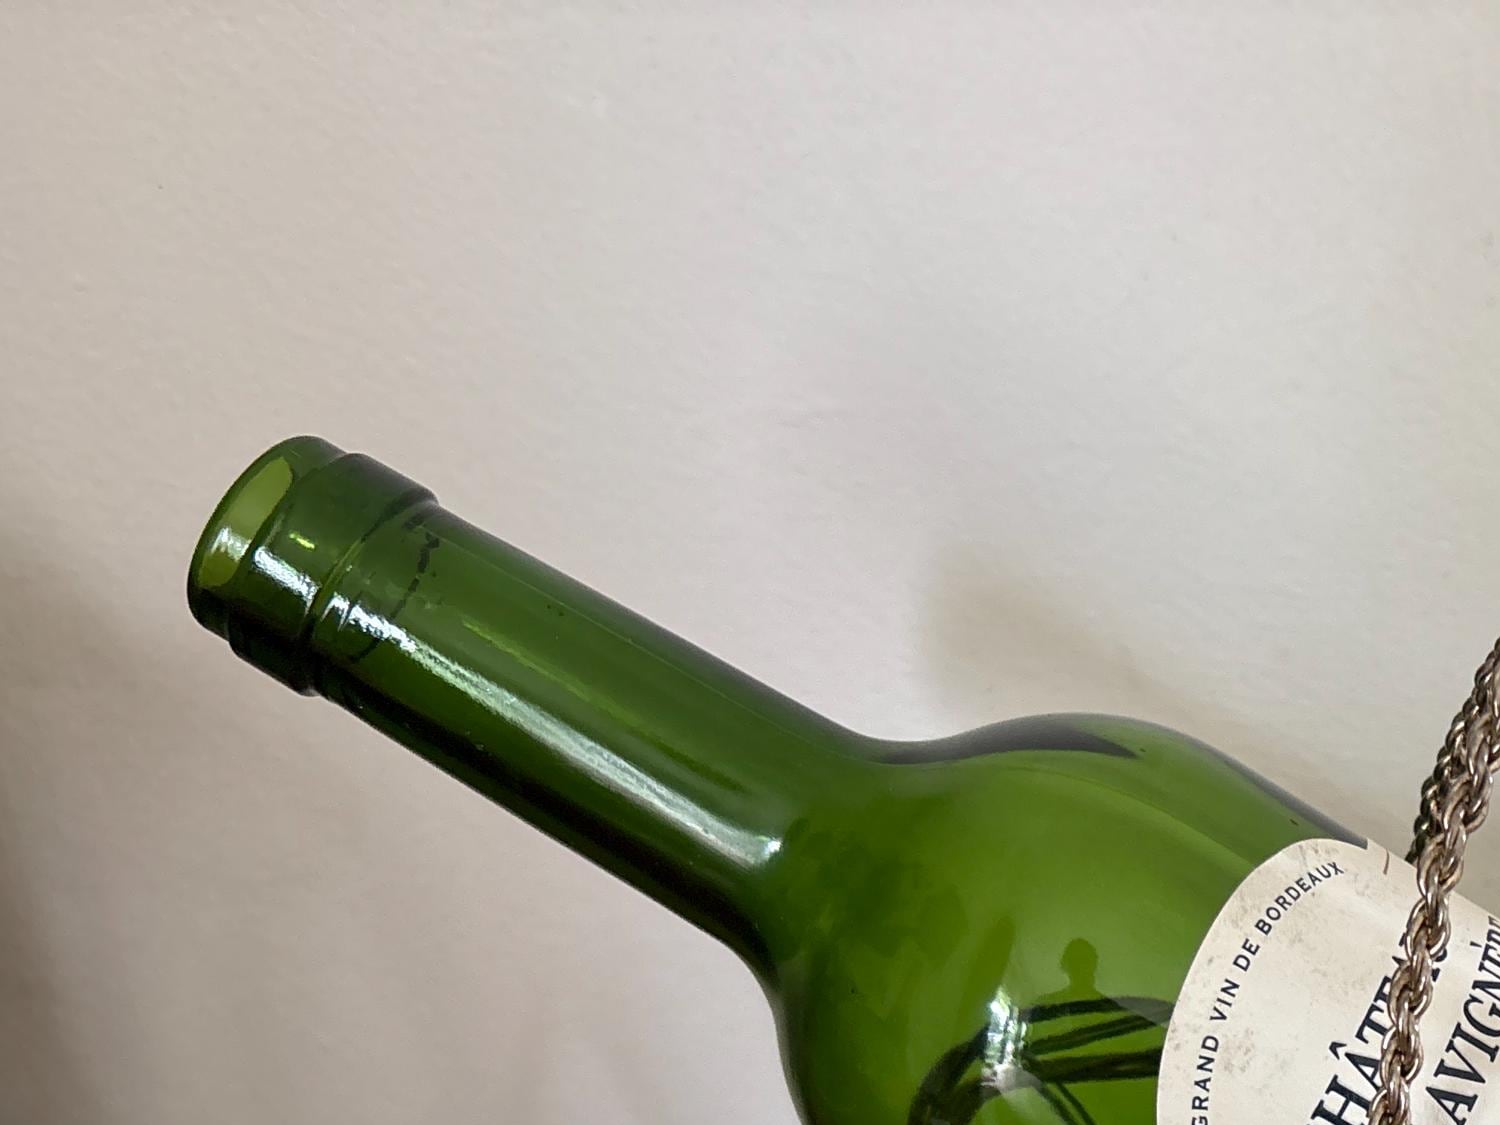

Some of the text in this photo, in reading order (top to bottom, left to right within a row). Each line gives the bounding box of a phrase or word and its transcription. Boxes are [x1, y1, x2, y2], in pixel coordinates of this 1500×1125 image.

[1209, 978, 1240, 1021] VIN
[1232, 938, 1260, 972] DE
[1254, 861, 1345, 936] BORDEAUX
